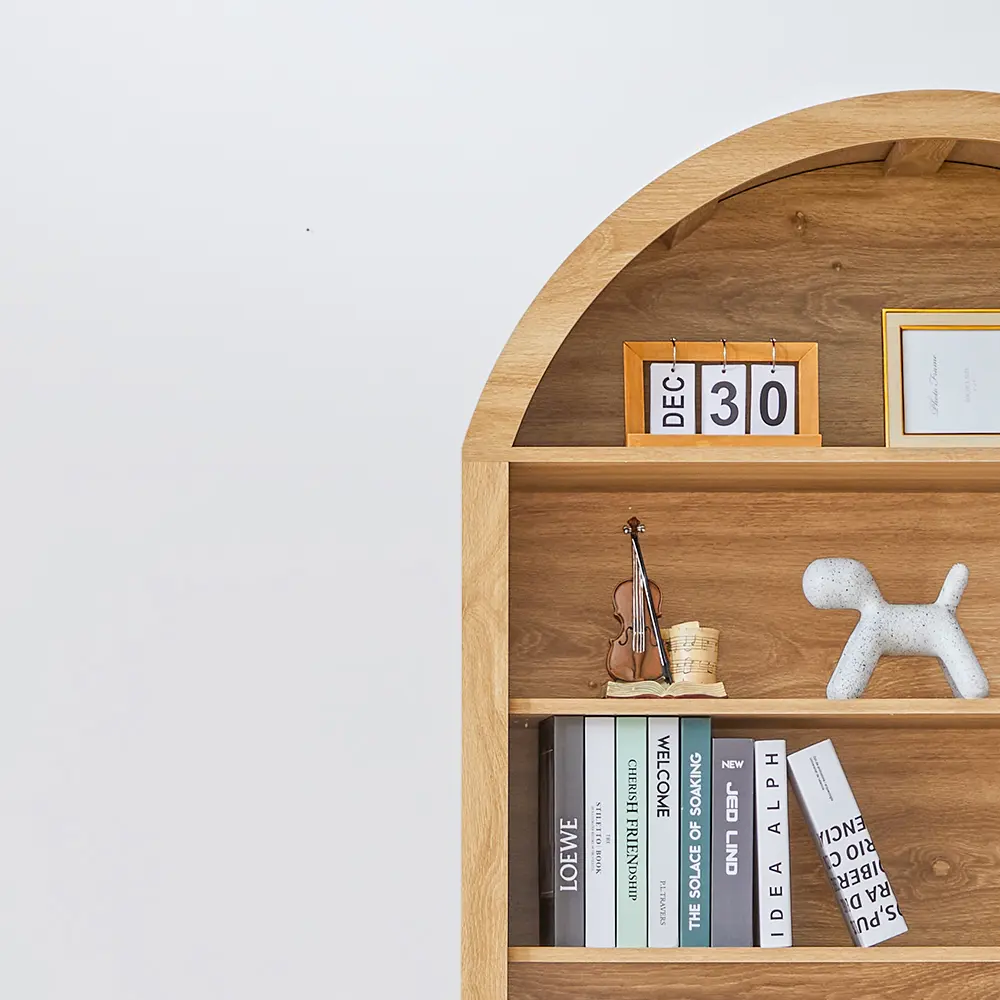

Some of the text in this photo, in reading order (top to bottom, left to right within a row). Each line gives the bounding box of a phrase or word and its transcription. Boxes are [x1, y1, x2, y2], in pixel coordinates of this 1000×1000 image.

[662, 376, 685, 428] DEC
[656, 735, 671, 818] WELCOME
[721, 760, 745, 769] NEW
[560, 817, 578, 892] LOEWE
[626, 758, 639, 902] CHERISH FRIENDSHIP
[688, 752, 702, 931] THE SOLACE OF SOAKING
[725, 781, 739, 876] JED LIND
[765, 753, 785, 937] IDEA ALPH
